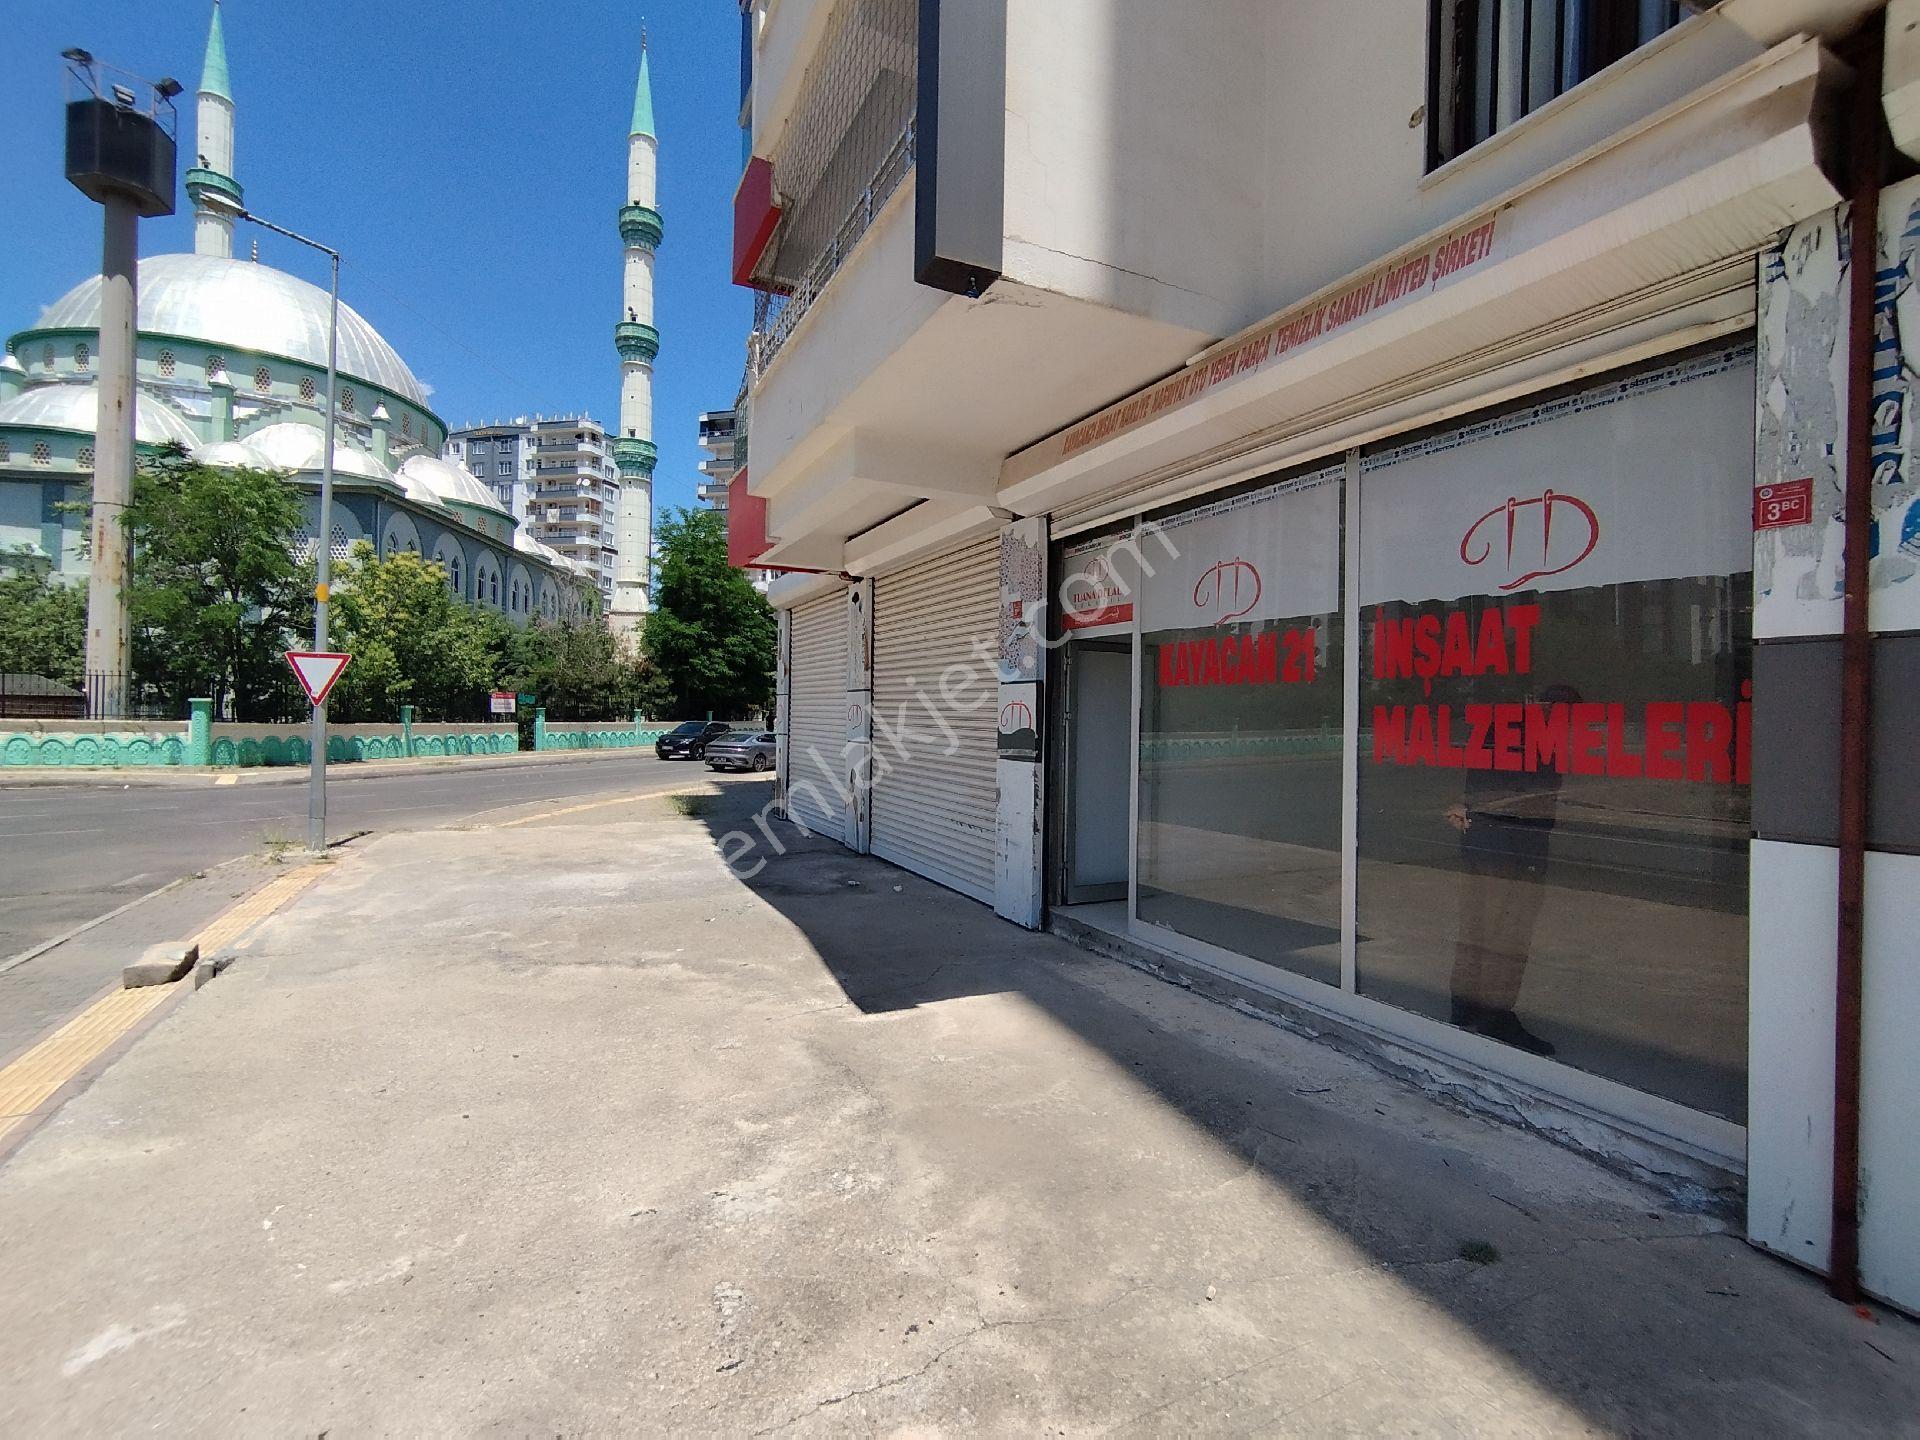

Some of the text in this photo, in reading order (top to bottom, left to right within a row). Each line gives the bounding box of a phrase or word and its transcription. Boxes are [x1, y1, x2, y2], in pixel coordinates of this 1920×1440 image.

[1275, 303, 1327, 355] TEMİZLİK
[1326, 273, 1376, 331] SANAYİ
[1374, 257, 1430, 309] LİMİTED
[1432, 211, 1497, 292] ŞİRKETİ
[1159, 628, 1316, 687] KAYACAN 21
[1373, 604, 1541, 698] İNŞAAT
[1373, 679, 1752, 785] MALZEMELERİ
